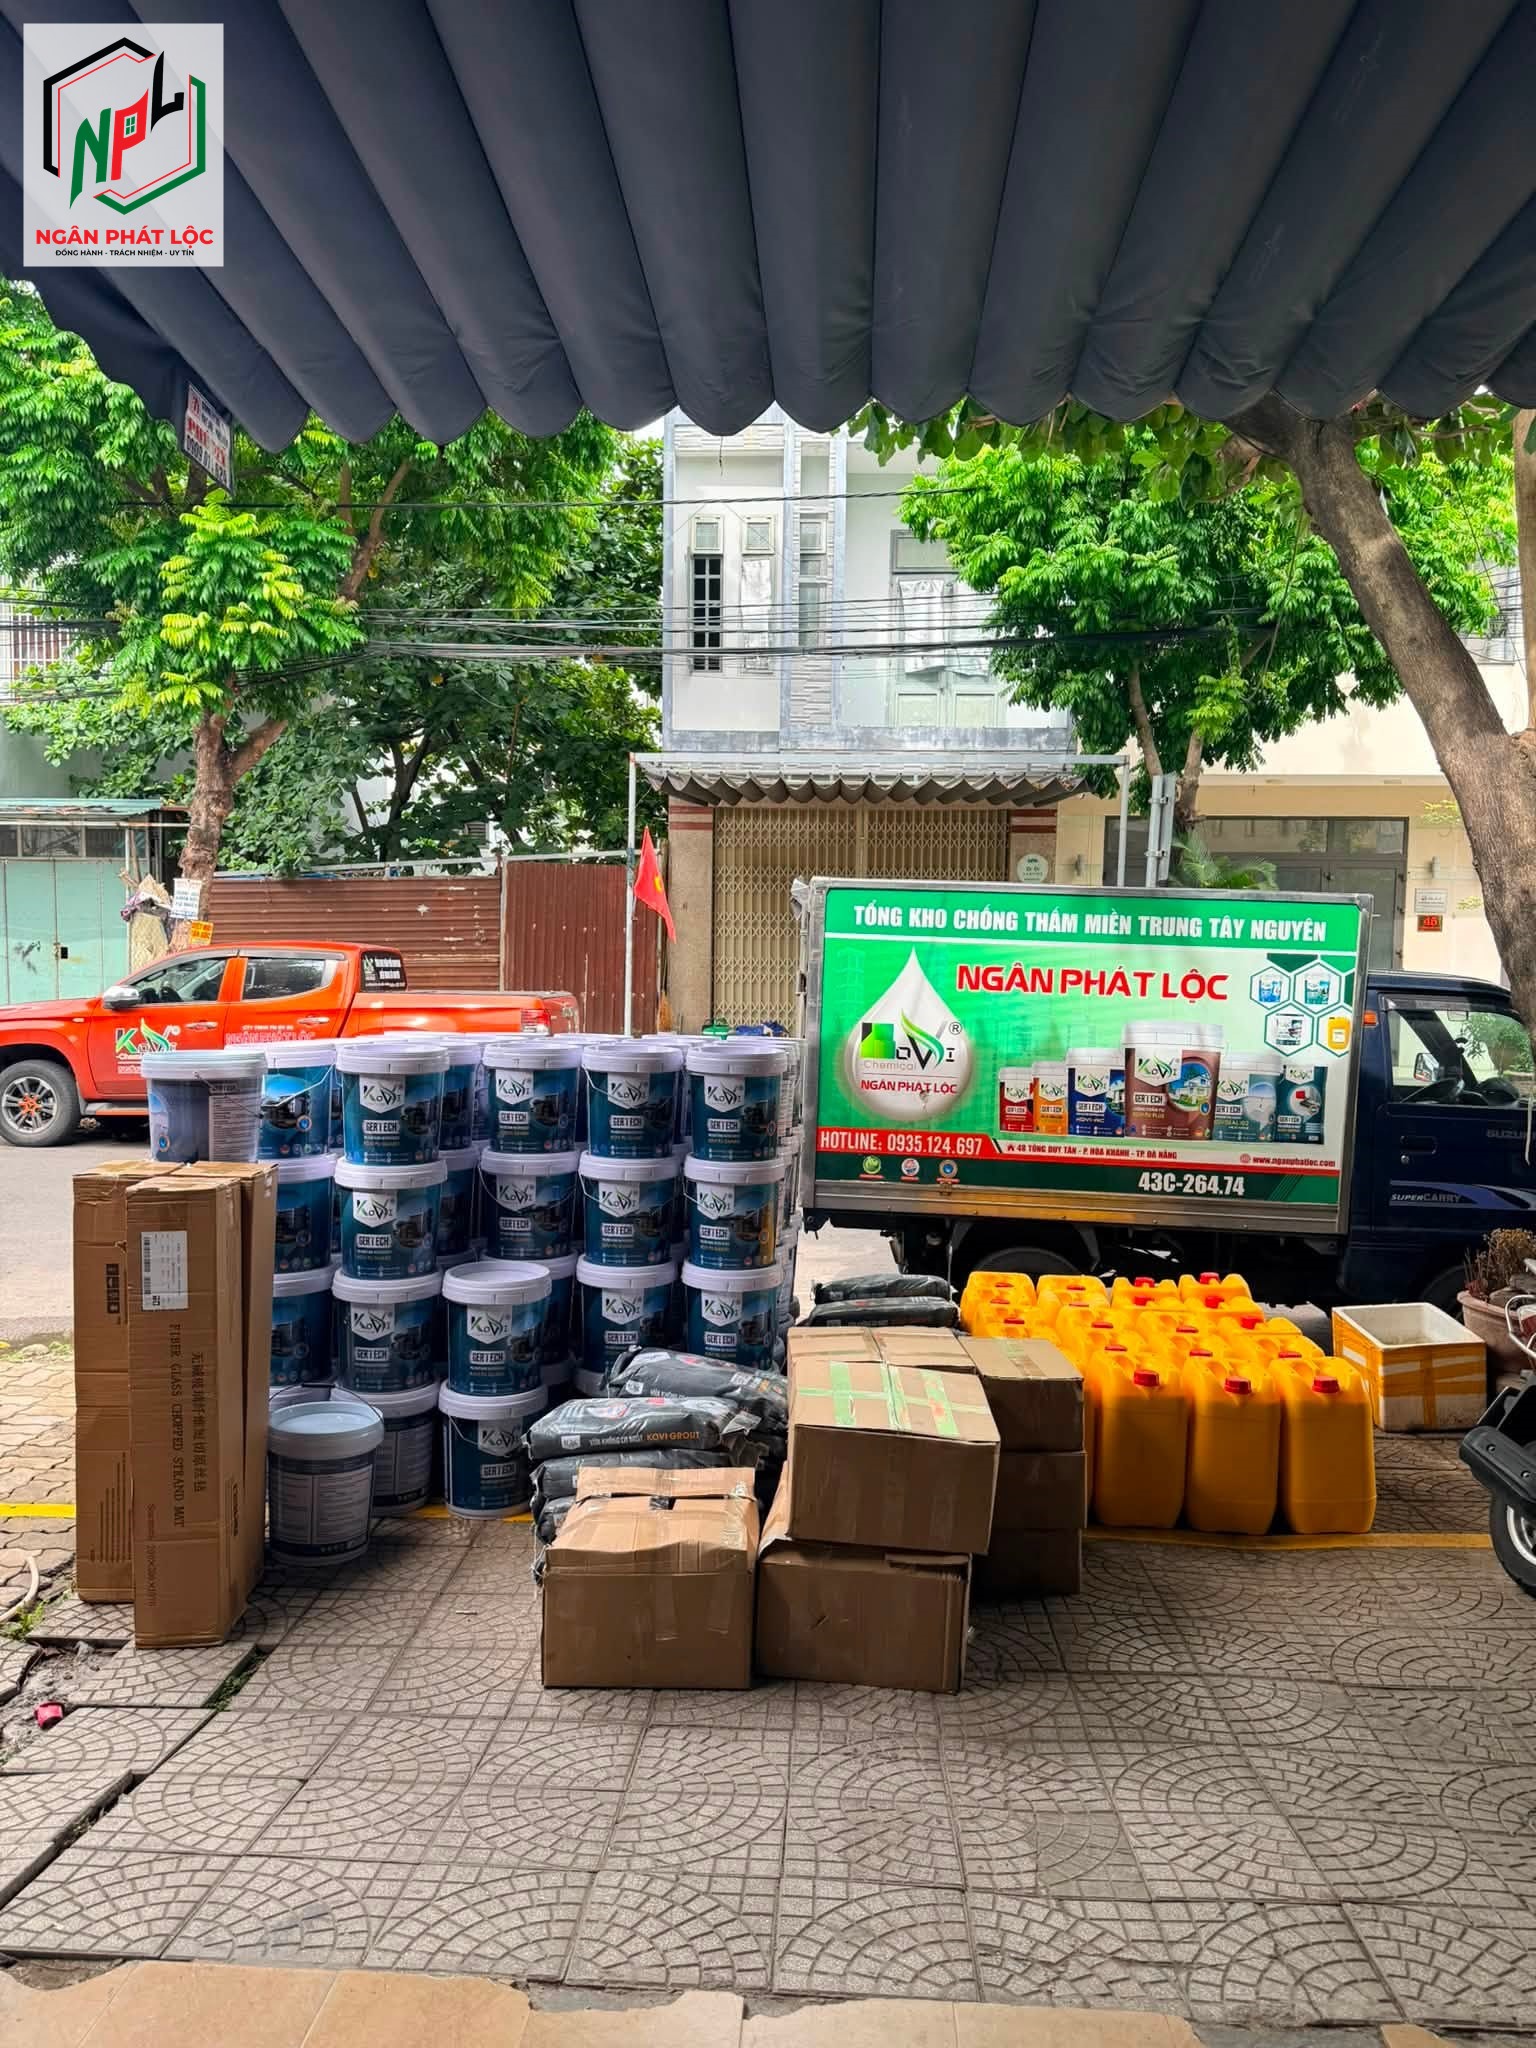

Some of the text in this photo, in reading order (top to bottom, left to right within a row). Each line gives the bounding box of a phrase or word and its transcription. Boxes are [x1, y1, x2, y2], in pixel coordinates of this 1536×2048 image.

[909, 907, 947, 928] KHO
[953, 903, 1019, 932] CHỐNG
[1025, 906, 1078, 934] THẤM
[1084, 908, 1132, 936] MIỀN
[1138, 915, 1202, 938] TRUNG
[1209, 915, 1245, 940] TÂY
[1250, 917, 1327, 942] NGUYÊN
[957, 962, 1230, 1004] NGÂN PHÁT LỘC
[863, 1060, 917, 1071] Chemical
[820, 1131, 983, 1156] HOTLINE: 0935.124.697
[1138, 1172, 1245, 1196] 43C-264.74
[169, 1322, 185, 1528] FIBER GLASS CHOPPED STRAND MAT
[647, 1432, 668, 1441] KOVI
[669, 1431, 700, 1441] GROUT
